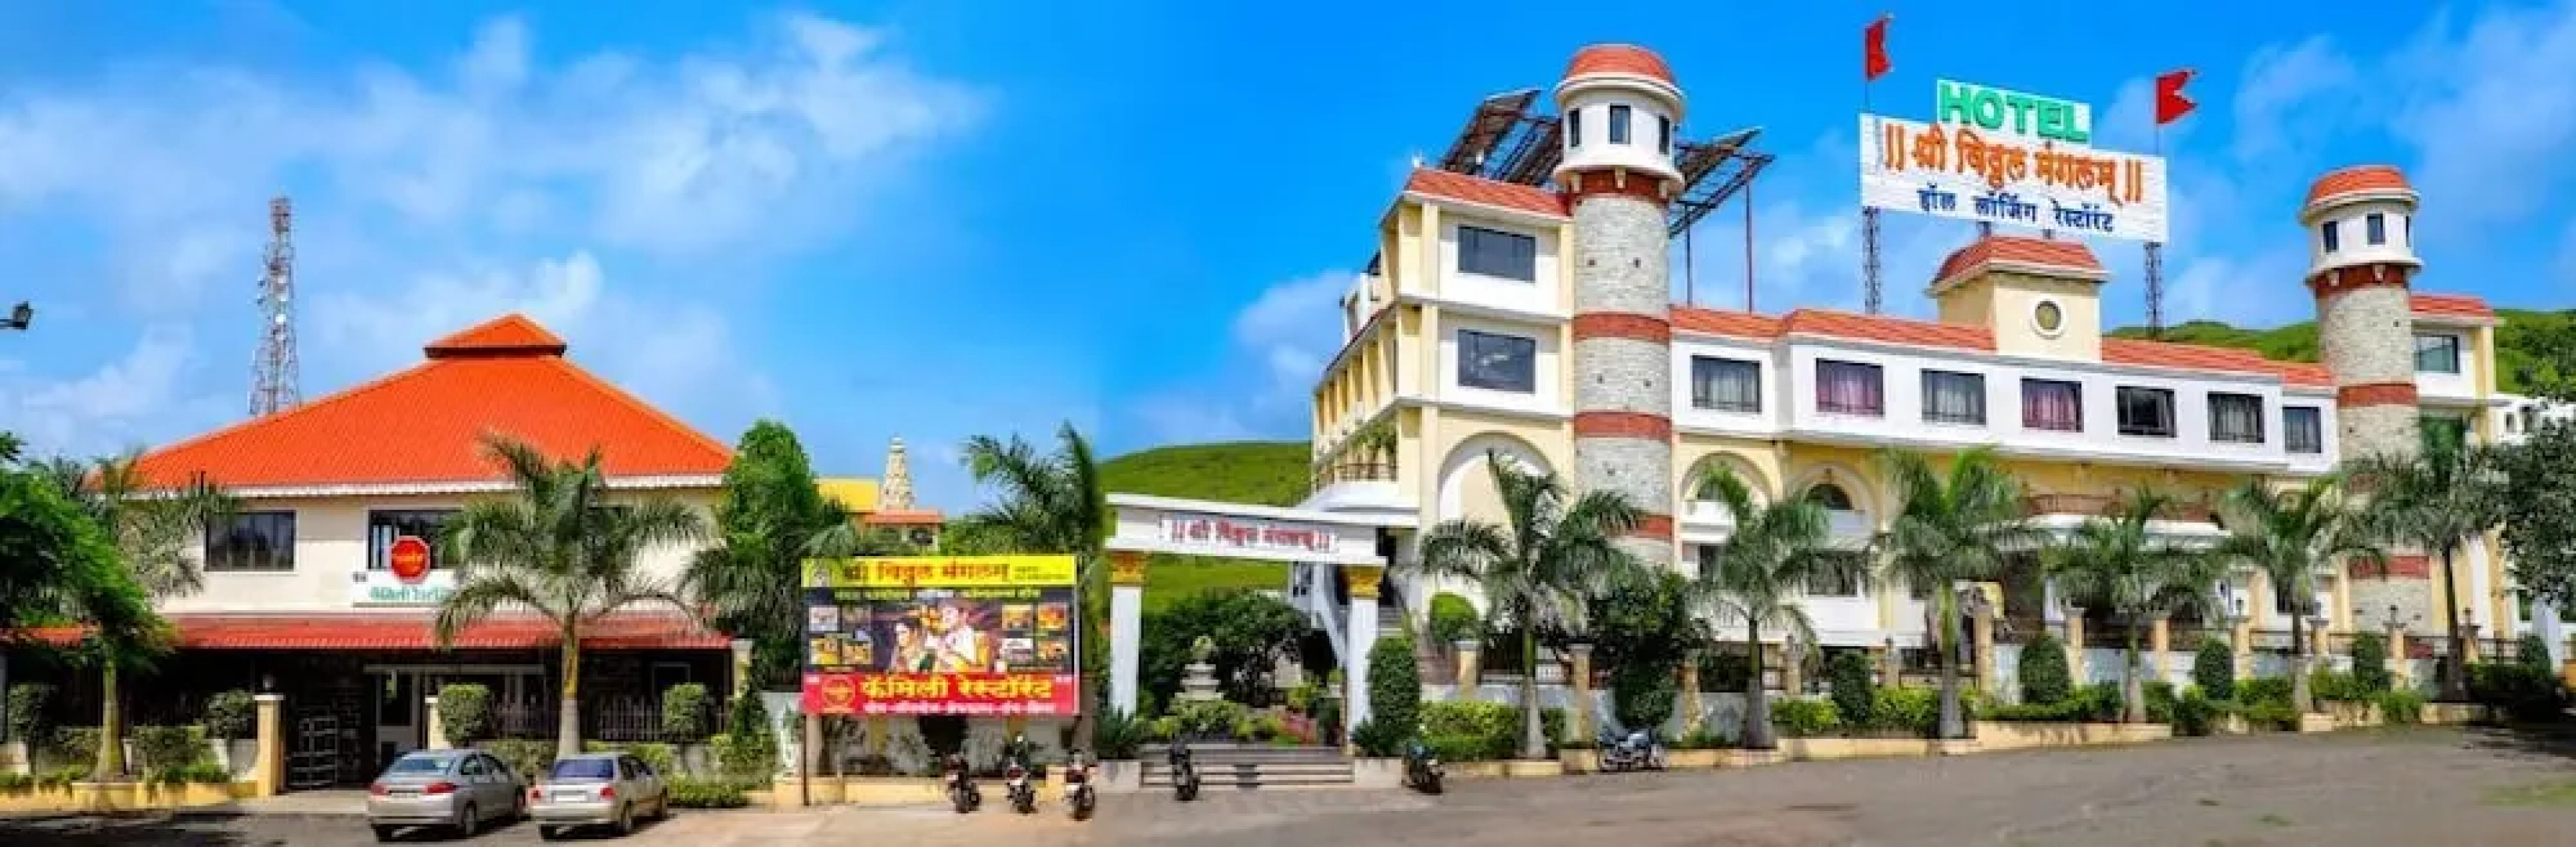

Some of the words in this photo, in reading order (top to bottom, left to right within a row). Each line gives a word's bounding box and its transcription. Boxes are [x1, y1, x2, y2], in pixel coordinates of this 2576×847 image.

[1940, 84, 2089, 144] HOTEL
[1912, 124, 1947, 172] श्री
[1916, 181, 1958, 212] हॉल
